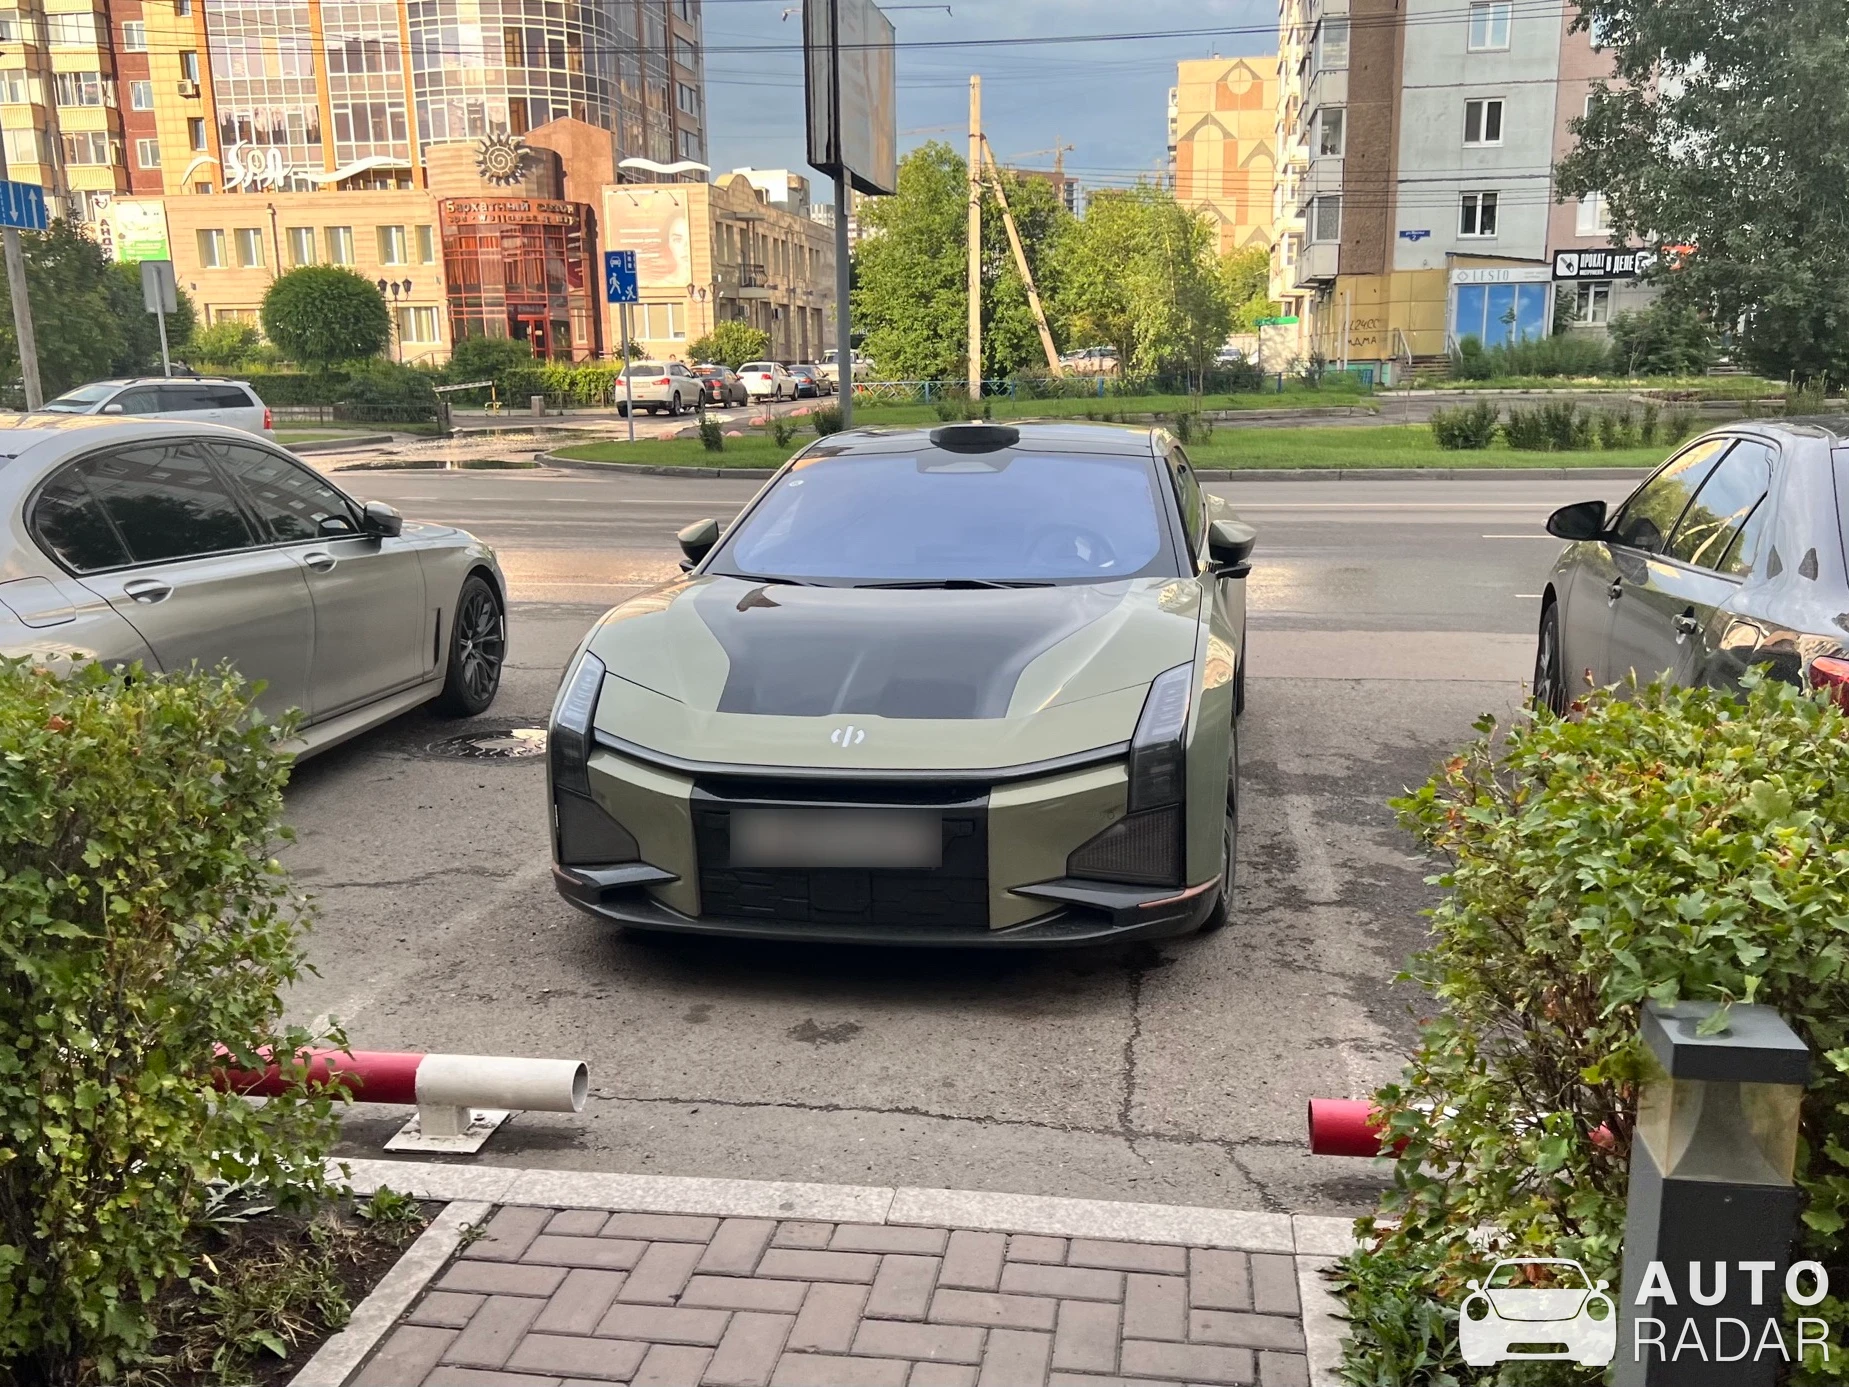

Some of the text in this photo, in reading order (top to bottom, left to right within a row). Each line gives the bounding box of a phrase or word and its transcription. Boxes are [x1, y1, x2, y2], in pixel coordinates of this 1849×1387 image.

[1580, 253, 1634, 274] ПРОКАТ В ДЕЛЕ
